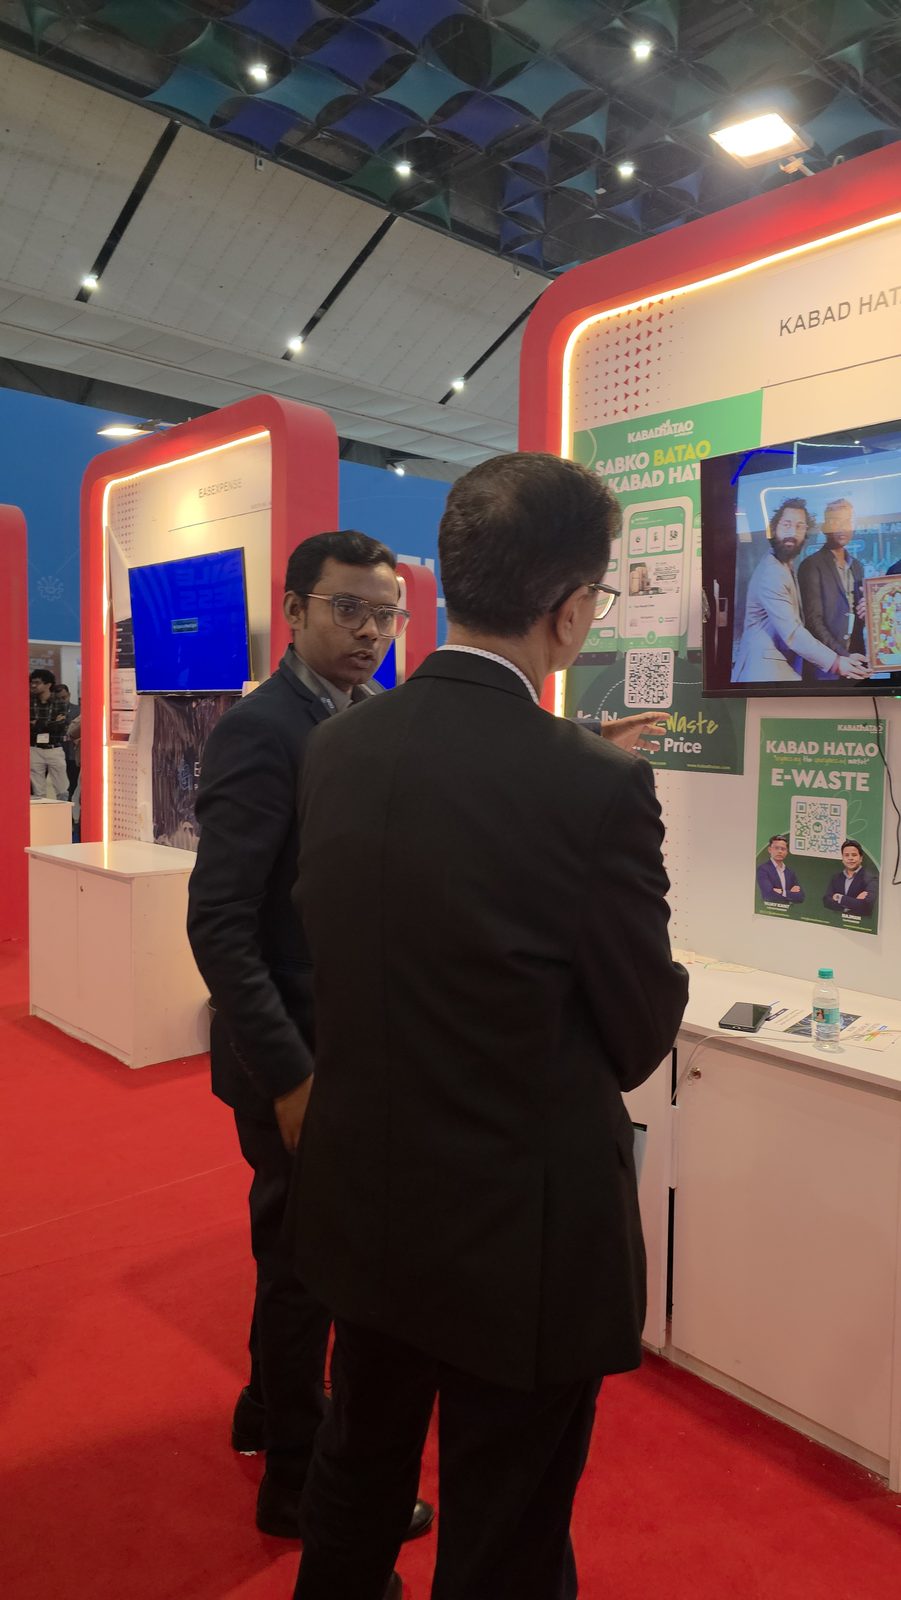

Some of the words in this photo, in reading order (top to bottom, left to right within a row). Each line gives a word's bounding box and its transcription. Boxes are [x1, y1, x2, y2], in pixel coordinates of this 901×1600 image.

[779, 301, 851, 336] KABAD
[858, 285, 901, 315] HAT
[595, 452, 650, 477] SABKO
[653, 440, 712, 467] BATAO
[608, 470, 665, 493] KABAD
[669, 463, 701, 485] HAT
[653, 711, 719, 735] -Waste
[664, 737, 702, 754] Price
[766, 740, 819, 755] KABAD
[823, 742, 879, 757] HATAO
[771, 768, 870, 792] E-WASTE
